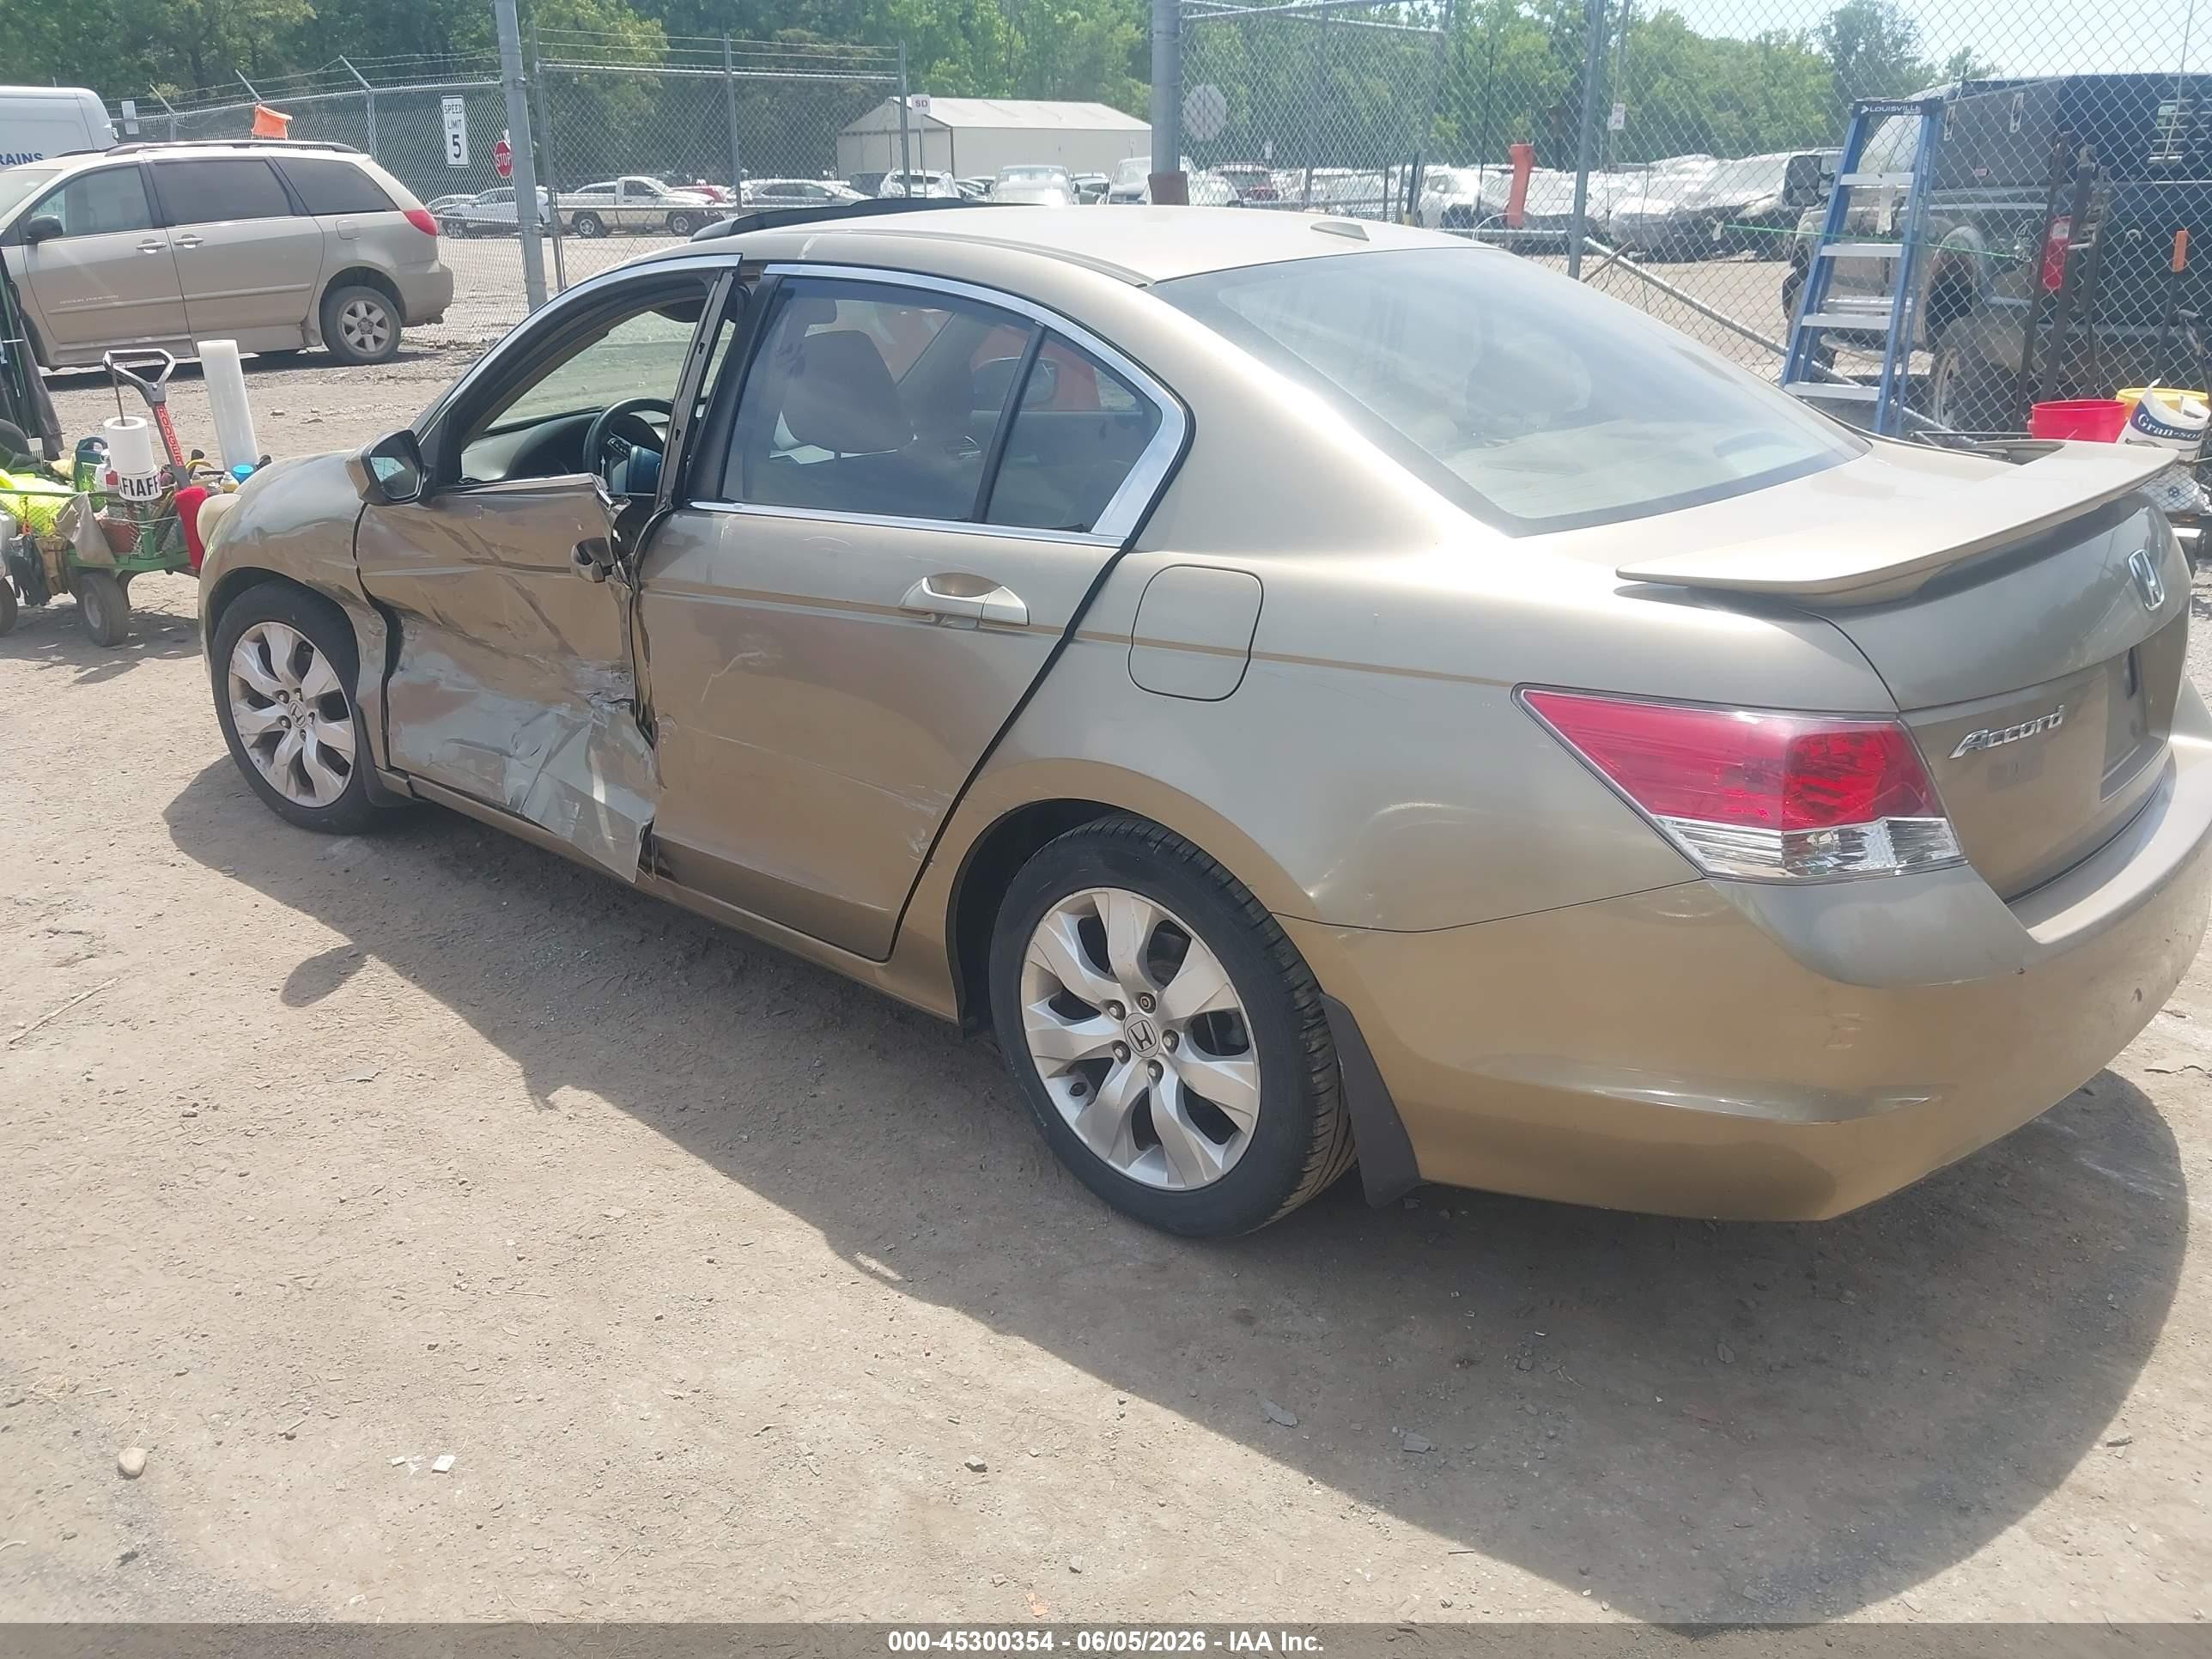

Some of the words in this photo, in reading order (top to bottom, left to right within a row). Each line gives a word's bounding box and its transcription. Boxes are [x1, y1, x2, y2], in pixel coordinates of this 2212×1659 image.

[444, 104, 463, 114] SPEED
[447, 119, 462, 129] LIMIT
[452, 134, 462, 159] 5
[495, 153, 511, 167] STOP
[1948, 704, 2064, 759] Accord
